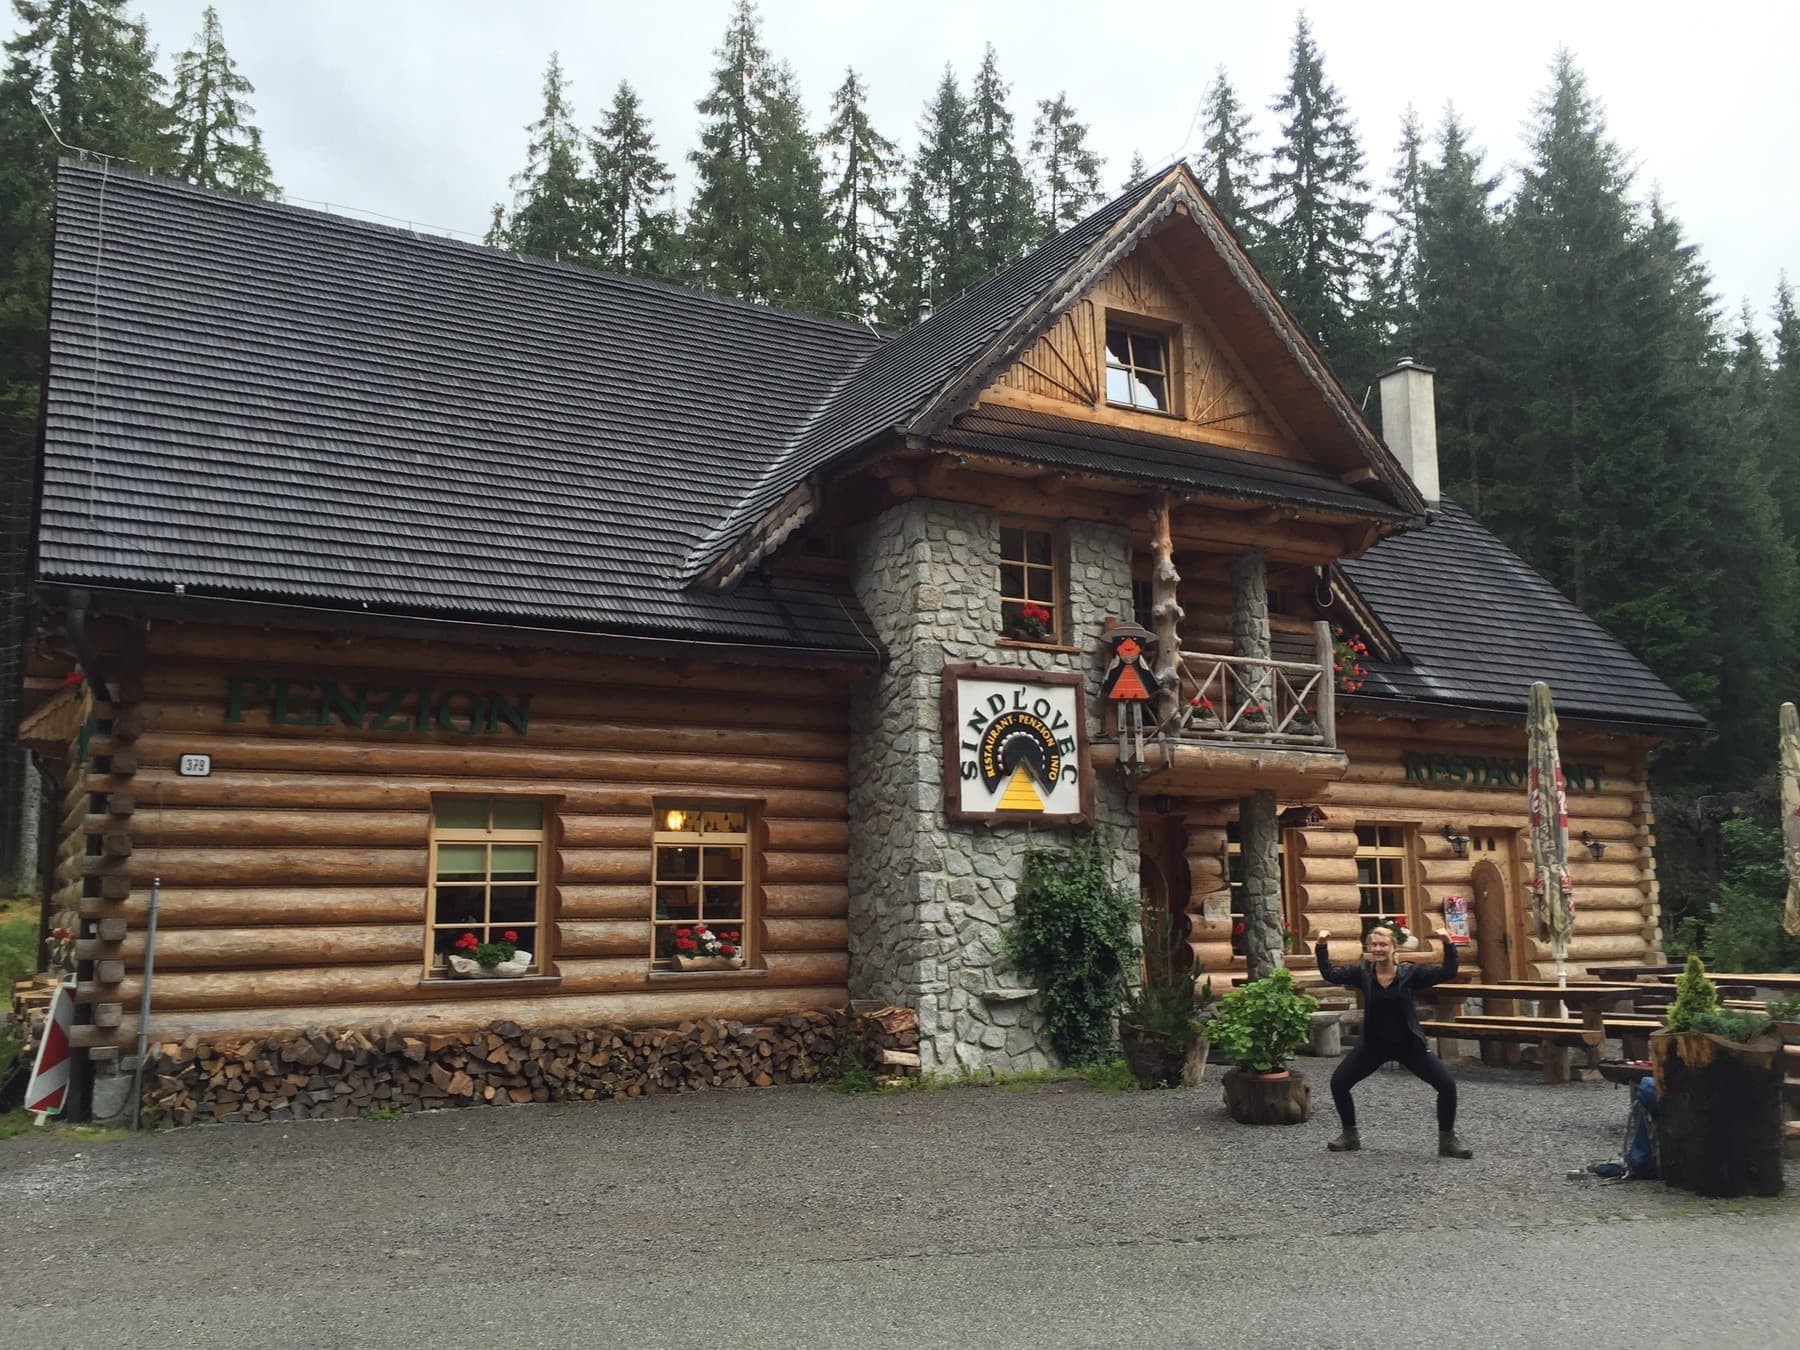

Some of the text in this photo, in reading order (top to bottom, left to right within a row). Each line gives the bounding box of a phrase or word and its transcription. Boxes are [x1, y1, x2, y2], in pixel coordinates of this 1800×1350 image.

[223, 675, 533, 736] PENZION
[1018, 714, 1055, 747] PENZION
[1048, 755, 1060, 781] INFO
[1406, 752, 1605, 792] RESTAUNT
